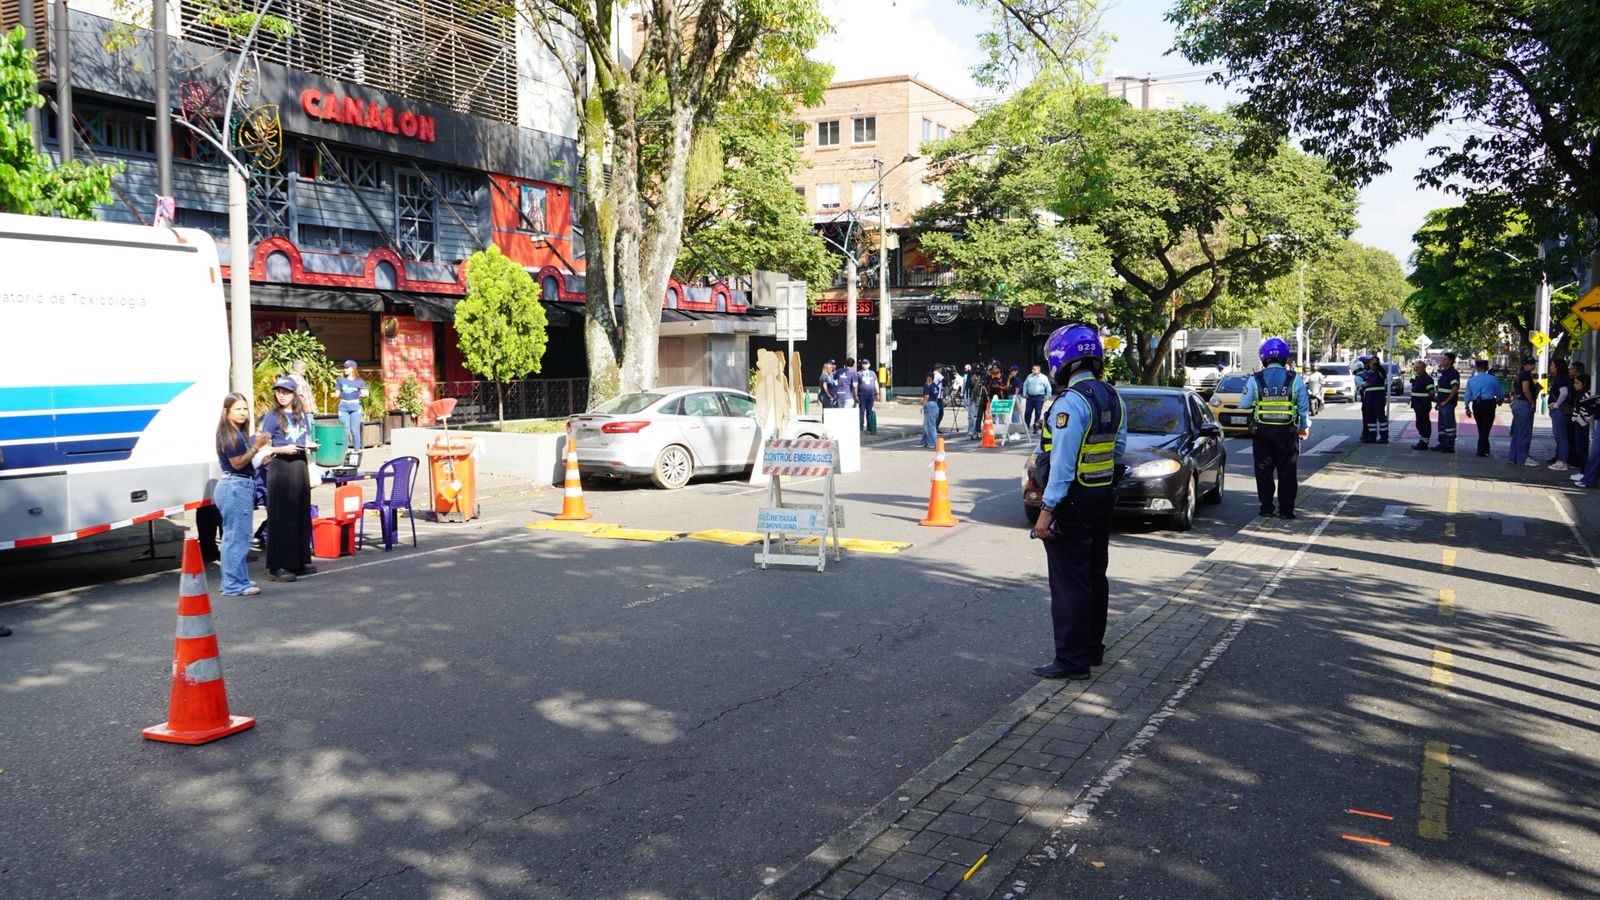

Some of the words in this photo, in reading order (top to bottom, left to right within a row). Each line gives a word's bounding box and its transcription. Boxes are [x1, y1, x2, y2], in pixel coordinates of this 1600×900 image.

[301, 88, 436, 142] CANALON
[0, 293, 44, 304] atorio
[49, 293, 66, 305] de
[814, 302, 870, 313] ICOEXPESS
[1077, 343, 1096, 352] 923
[763, 452, 792, 462] CONTROL
[793, 453, 833, 463] EMBRIAGUEZ
